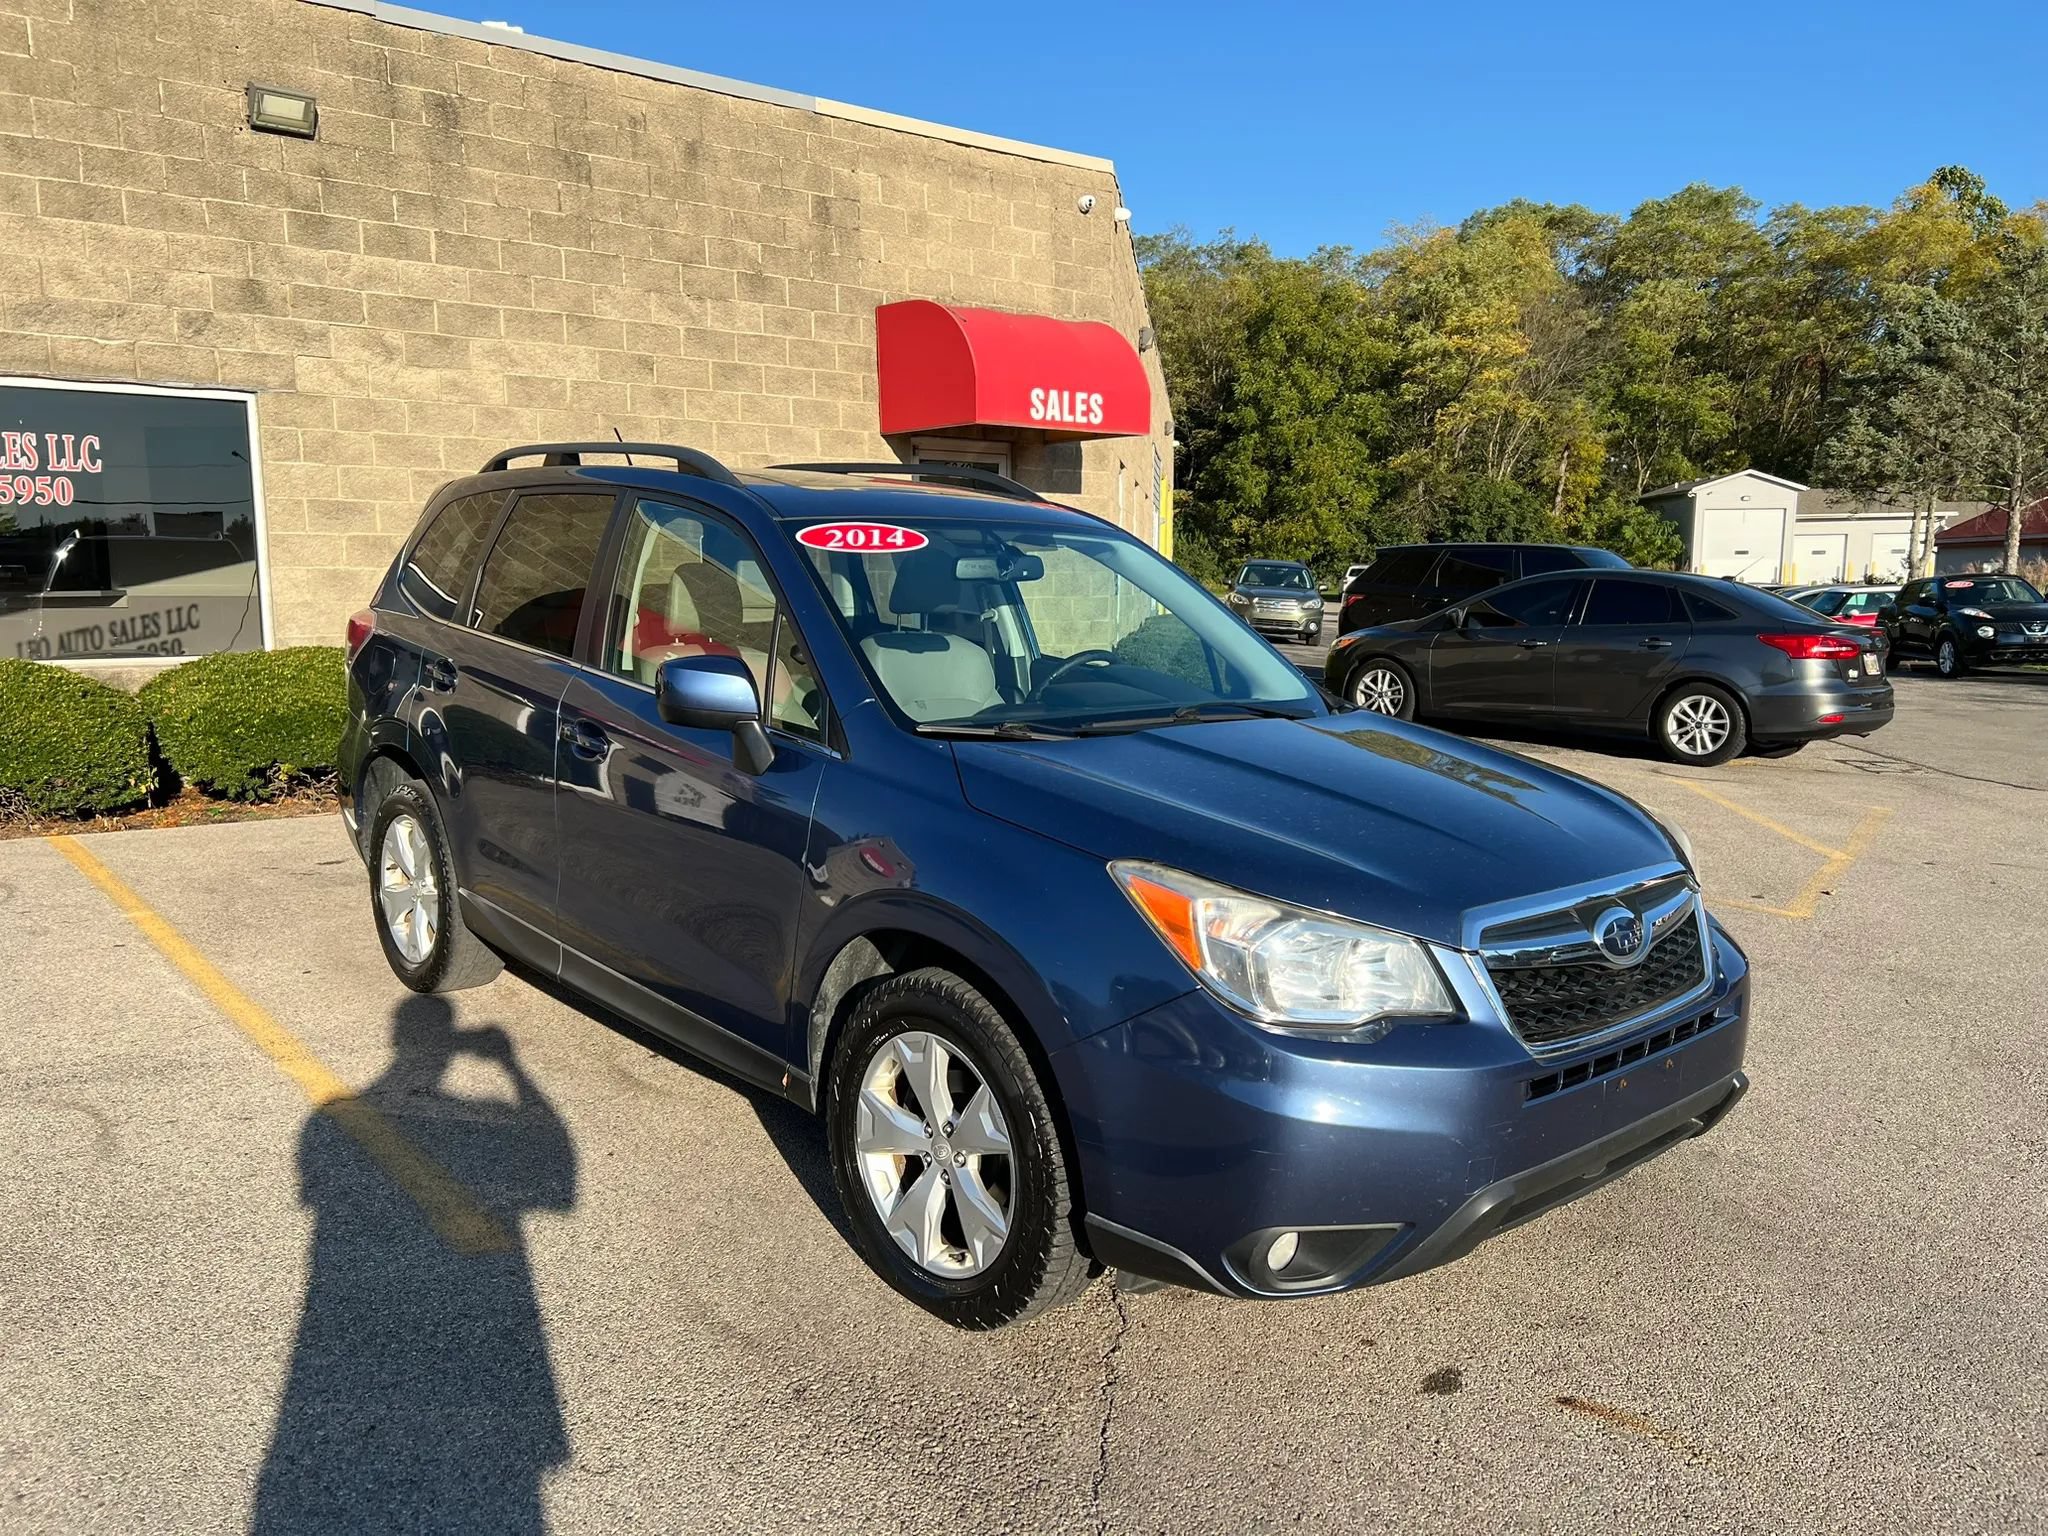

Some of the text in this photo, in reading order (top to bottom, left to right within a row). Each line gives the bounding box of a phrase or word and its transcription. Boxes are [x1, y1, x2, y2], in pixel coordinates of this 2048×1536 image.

[1029, 387, 1104, 425] SALES
[45, 433, 102, 473] LLC
[824, 528, 906, 548] 2014
[108, 611, 162, 647] SALES
[166, 603, 200, 634] LLC
